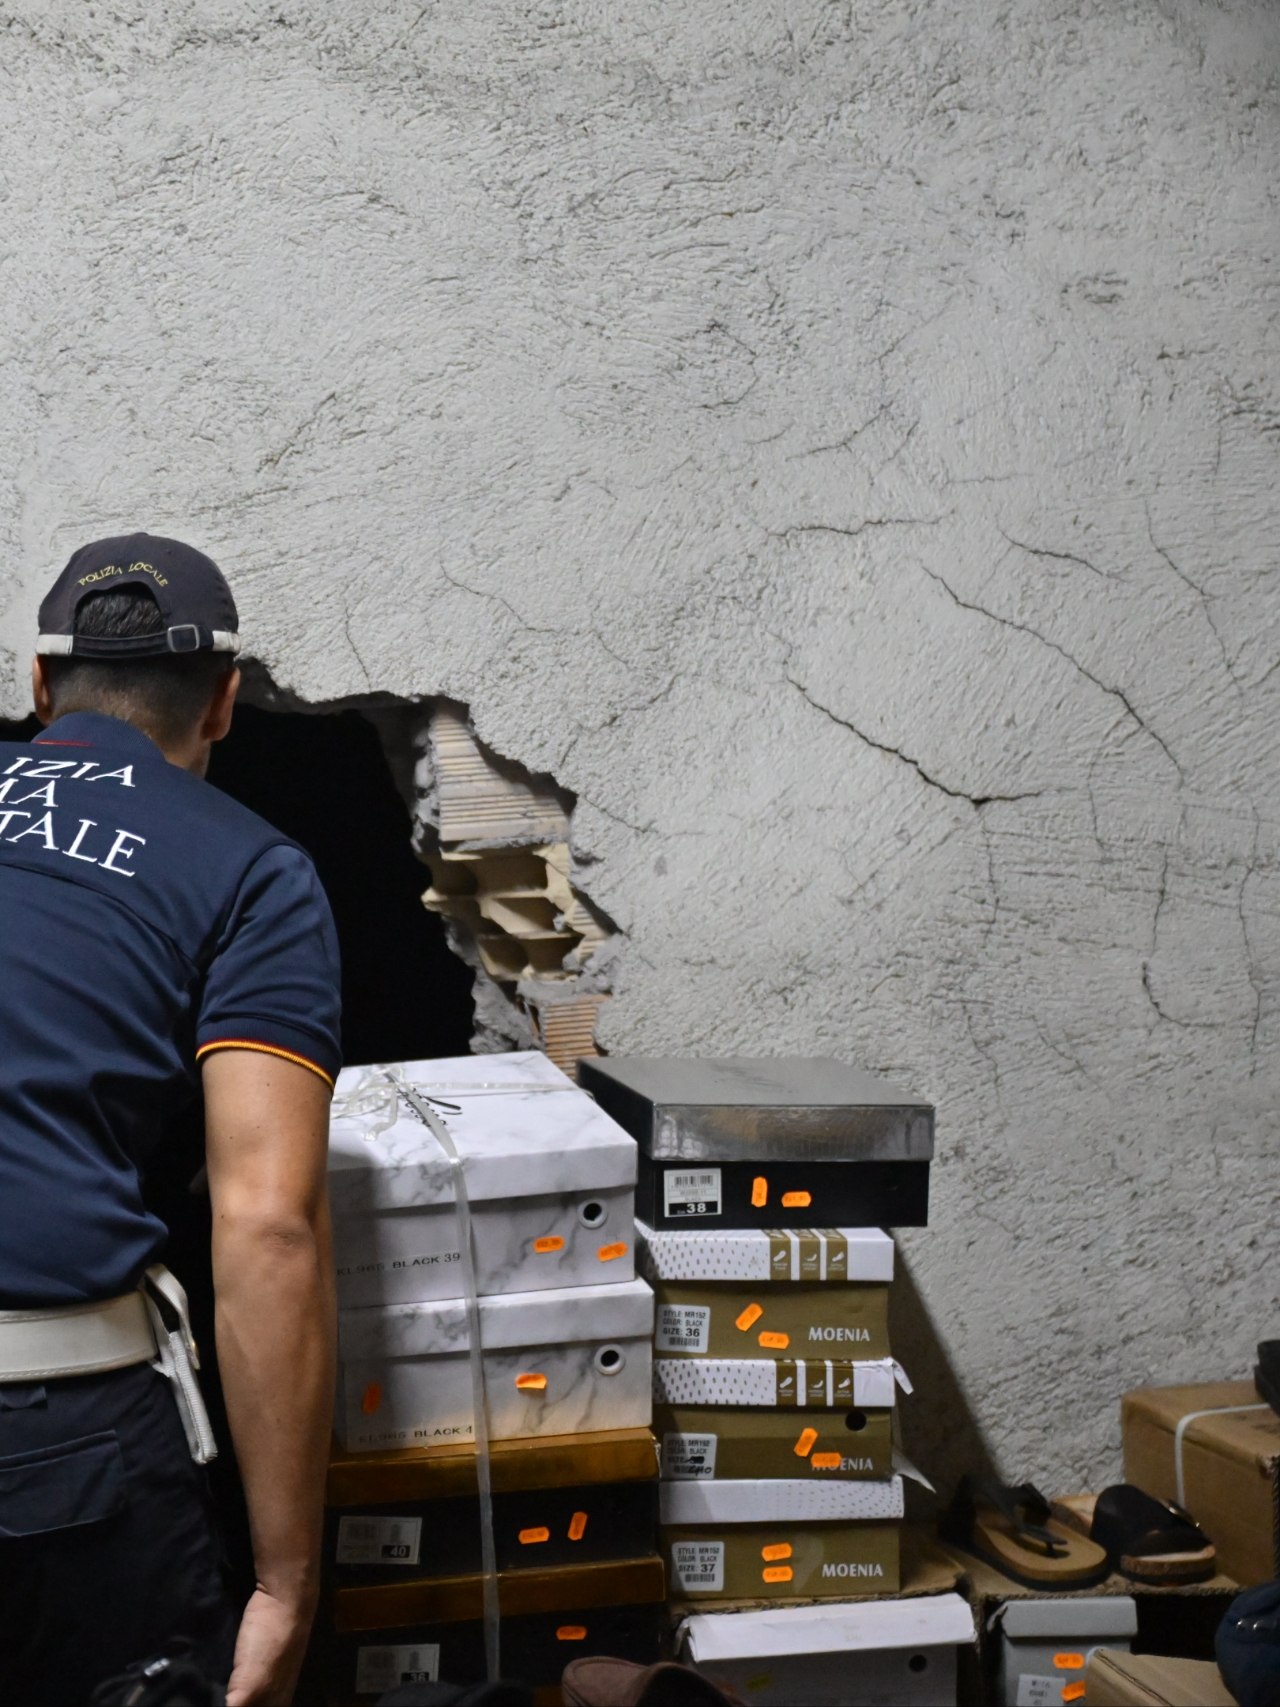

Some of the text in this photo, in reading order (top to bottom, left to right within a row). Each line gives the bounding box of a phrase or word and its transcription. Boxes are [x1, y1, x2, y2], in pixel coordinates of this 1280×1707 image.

[78, 562, 169, 587] POLIZIA LOCALE
[686, 1202, 707, 1214] 38
[392, 1256, 439, 1269] BLACK
[444, 1252, 461, 1263] 39
[685, 1328, 700, 1337] 36
[808, 1327, 871, 1342] MOENIA
[413, 1426, 460, 1438] BLACK
[465, 1425, 474, 1435] 4
[389, 1546, 407, 1557] 40
[700, 1563, 716, 1573] 37
[821, 1563, 883, 1578] MOENIA
